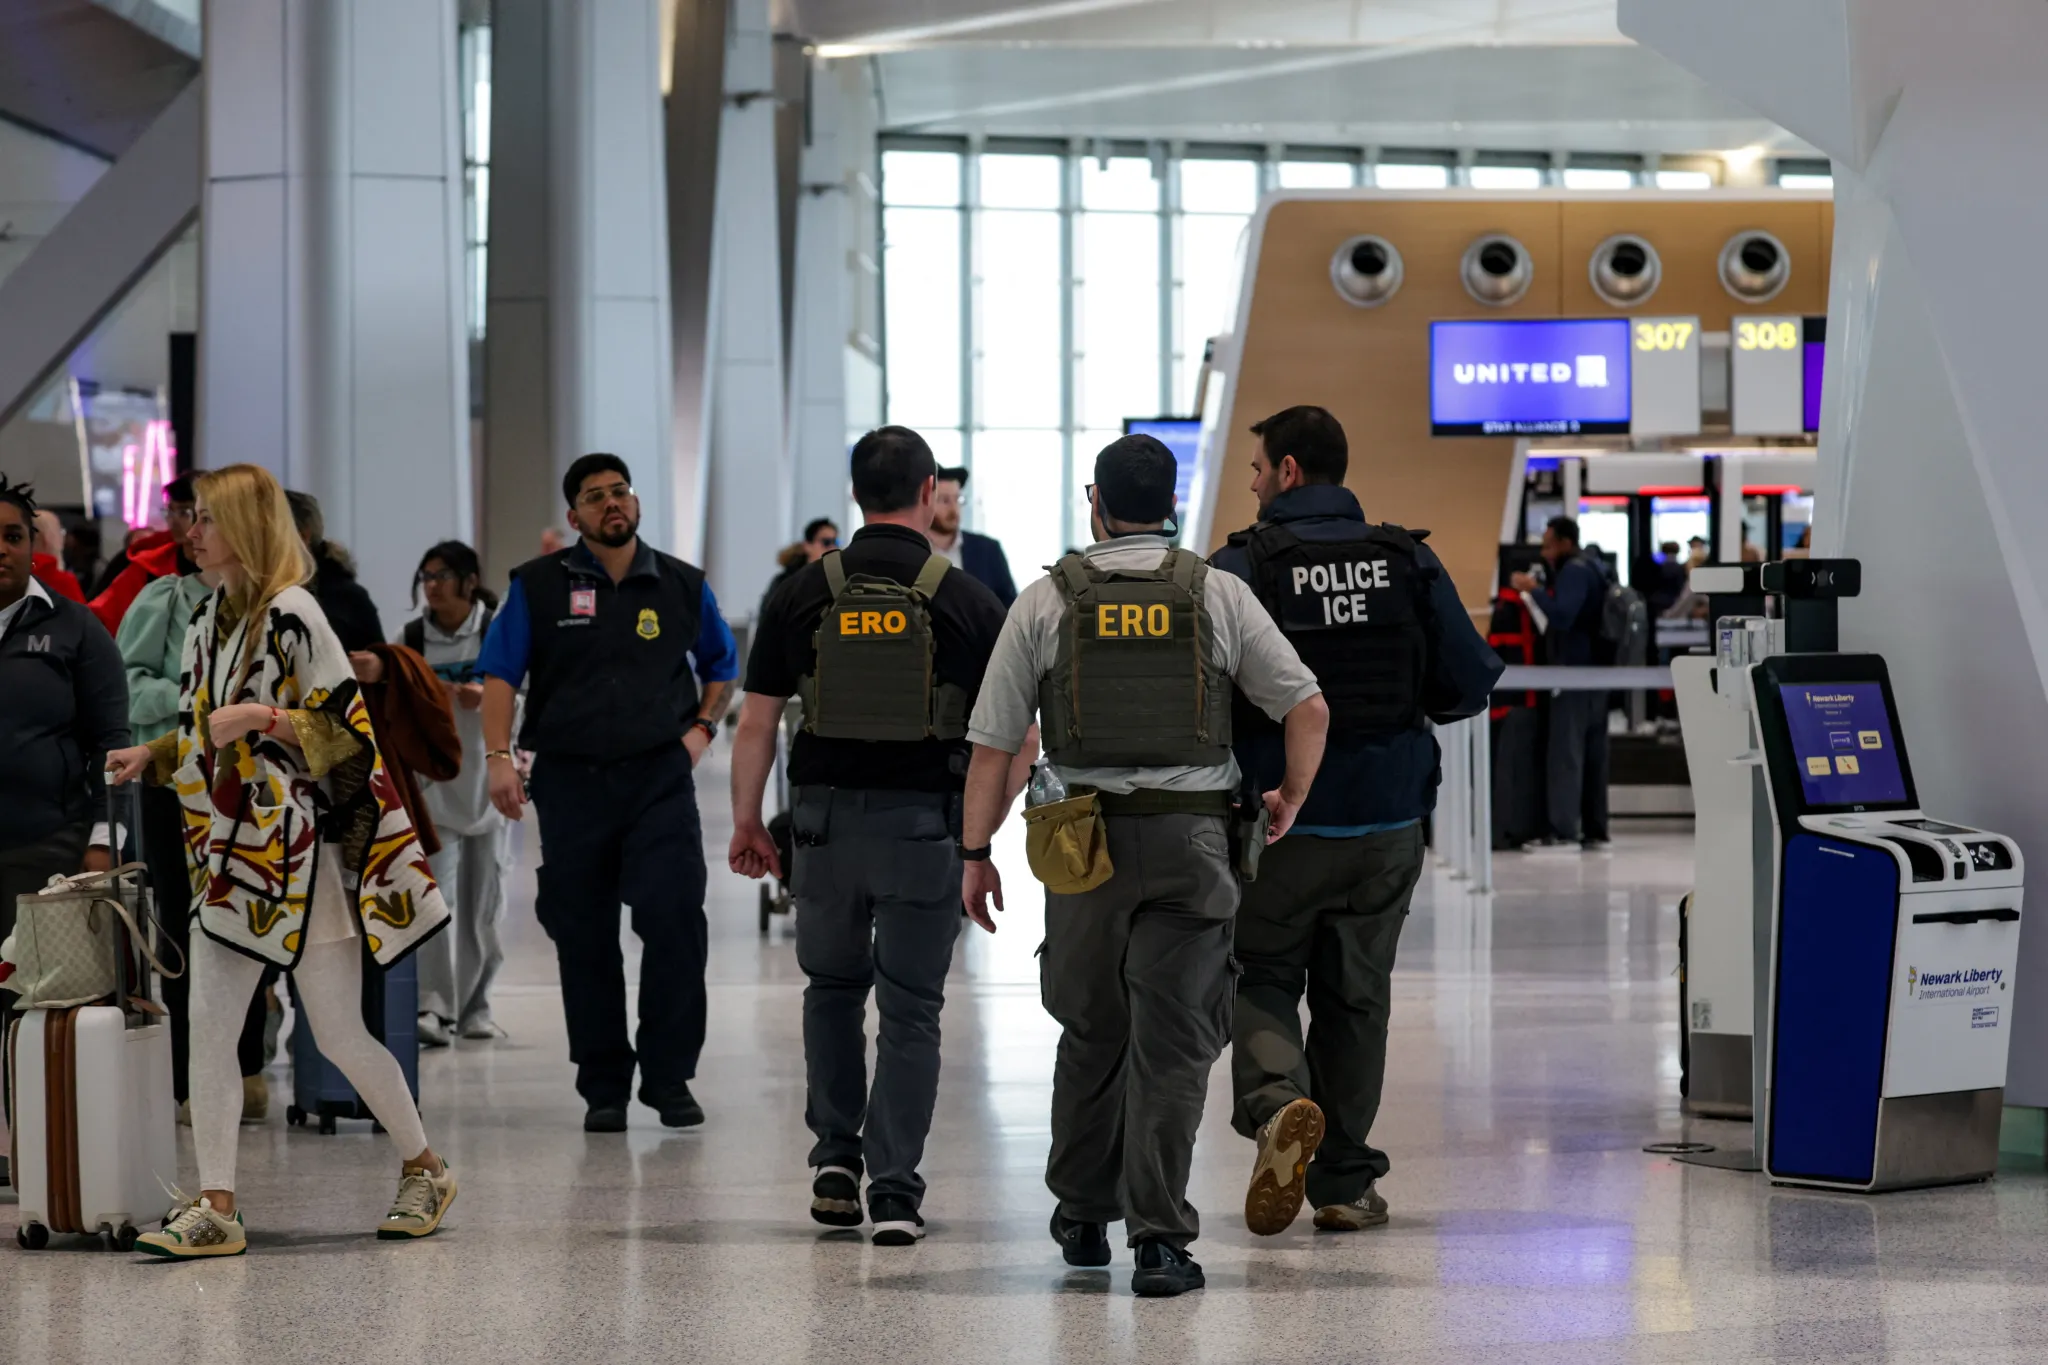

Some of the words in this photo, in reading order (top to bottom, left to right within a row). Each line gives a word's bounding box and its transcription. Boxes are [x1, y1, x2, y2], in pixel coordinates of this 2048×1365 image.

[1636, 322, 1693, 351] 307
[1737, 322, 1797, 350] 308
[1453, 362, 1572, 385] UNITED
[1292, 559, 1390, 595] POLICE
[1097, 603, 1170, 637] ERO
[1323, 594, 1369, 625] ICE
[839, 610, 907, 635] ERO
[27, 634, 51, 653] M
[1812, 694, 1834, 702] Newark
[1835, 693, 1854, 703] Liberty
[1920, 970, 1963, 986] Newark
[1963, 968, 2003, 984] Liberty
[1918, 987, 1965, 1000] International
[1966, 985, 1990, 998] Airport
